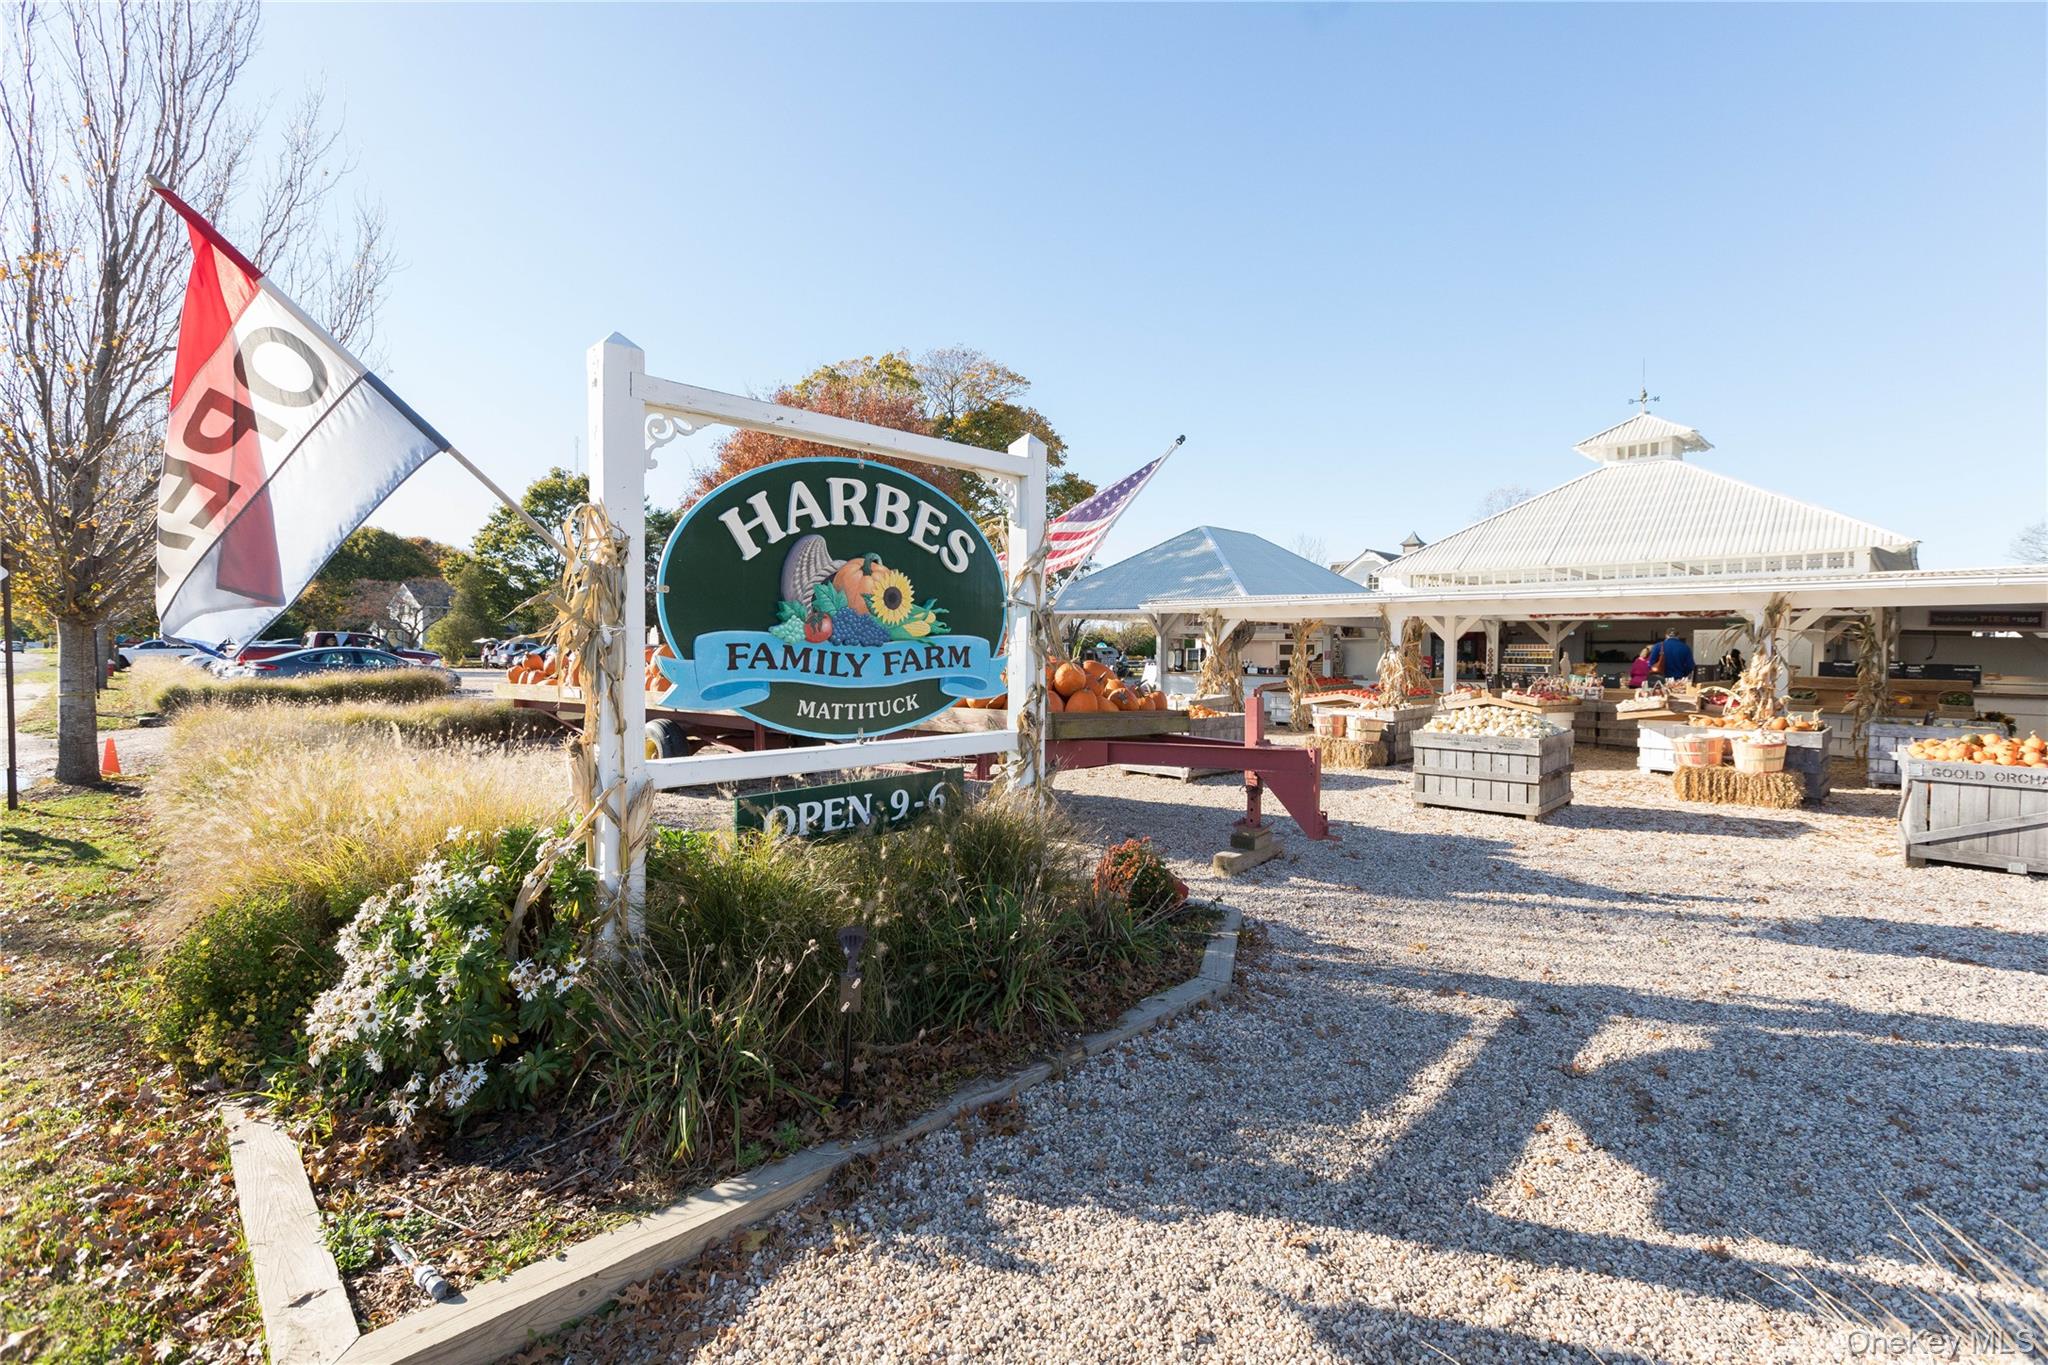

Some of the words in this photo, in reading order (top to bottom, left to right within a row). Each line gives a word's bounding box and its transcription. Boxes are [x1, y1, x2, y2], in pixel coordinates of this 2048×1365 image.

[718, 477, 976, 574] HARBES
[725, 642, 871, 678] FAMILY
[883, 645, 971, 676] FARM
[797, 693, 920, 720] MATTITUCK
[1931, 767, 1985, 781] GOOLD
[763, 793, 873, 836] OPEN
